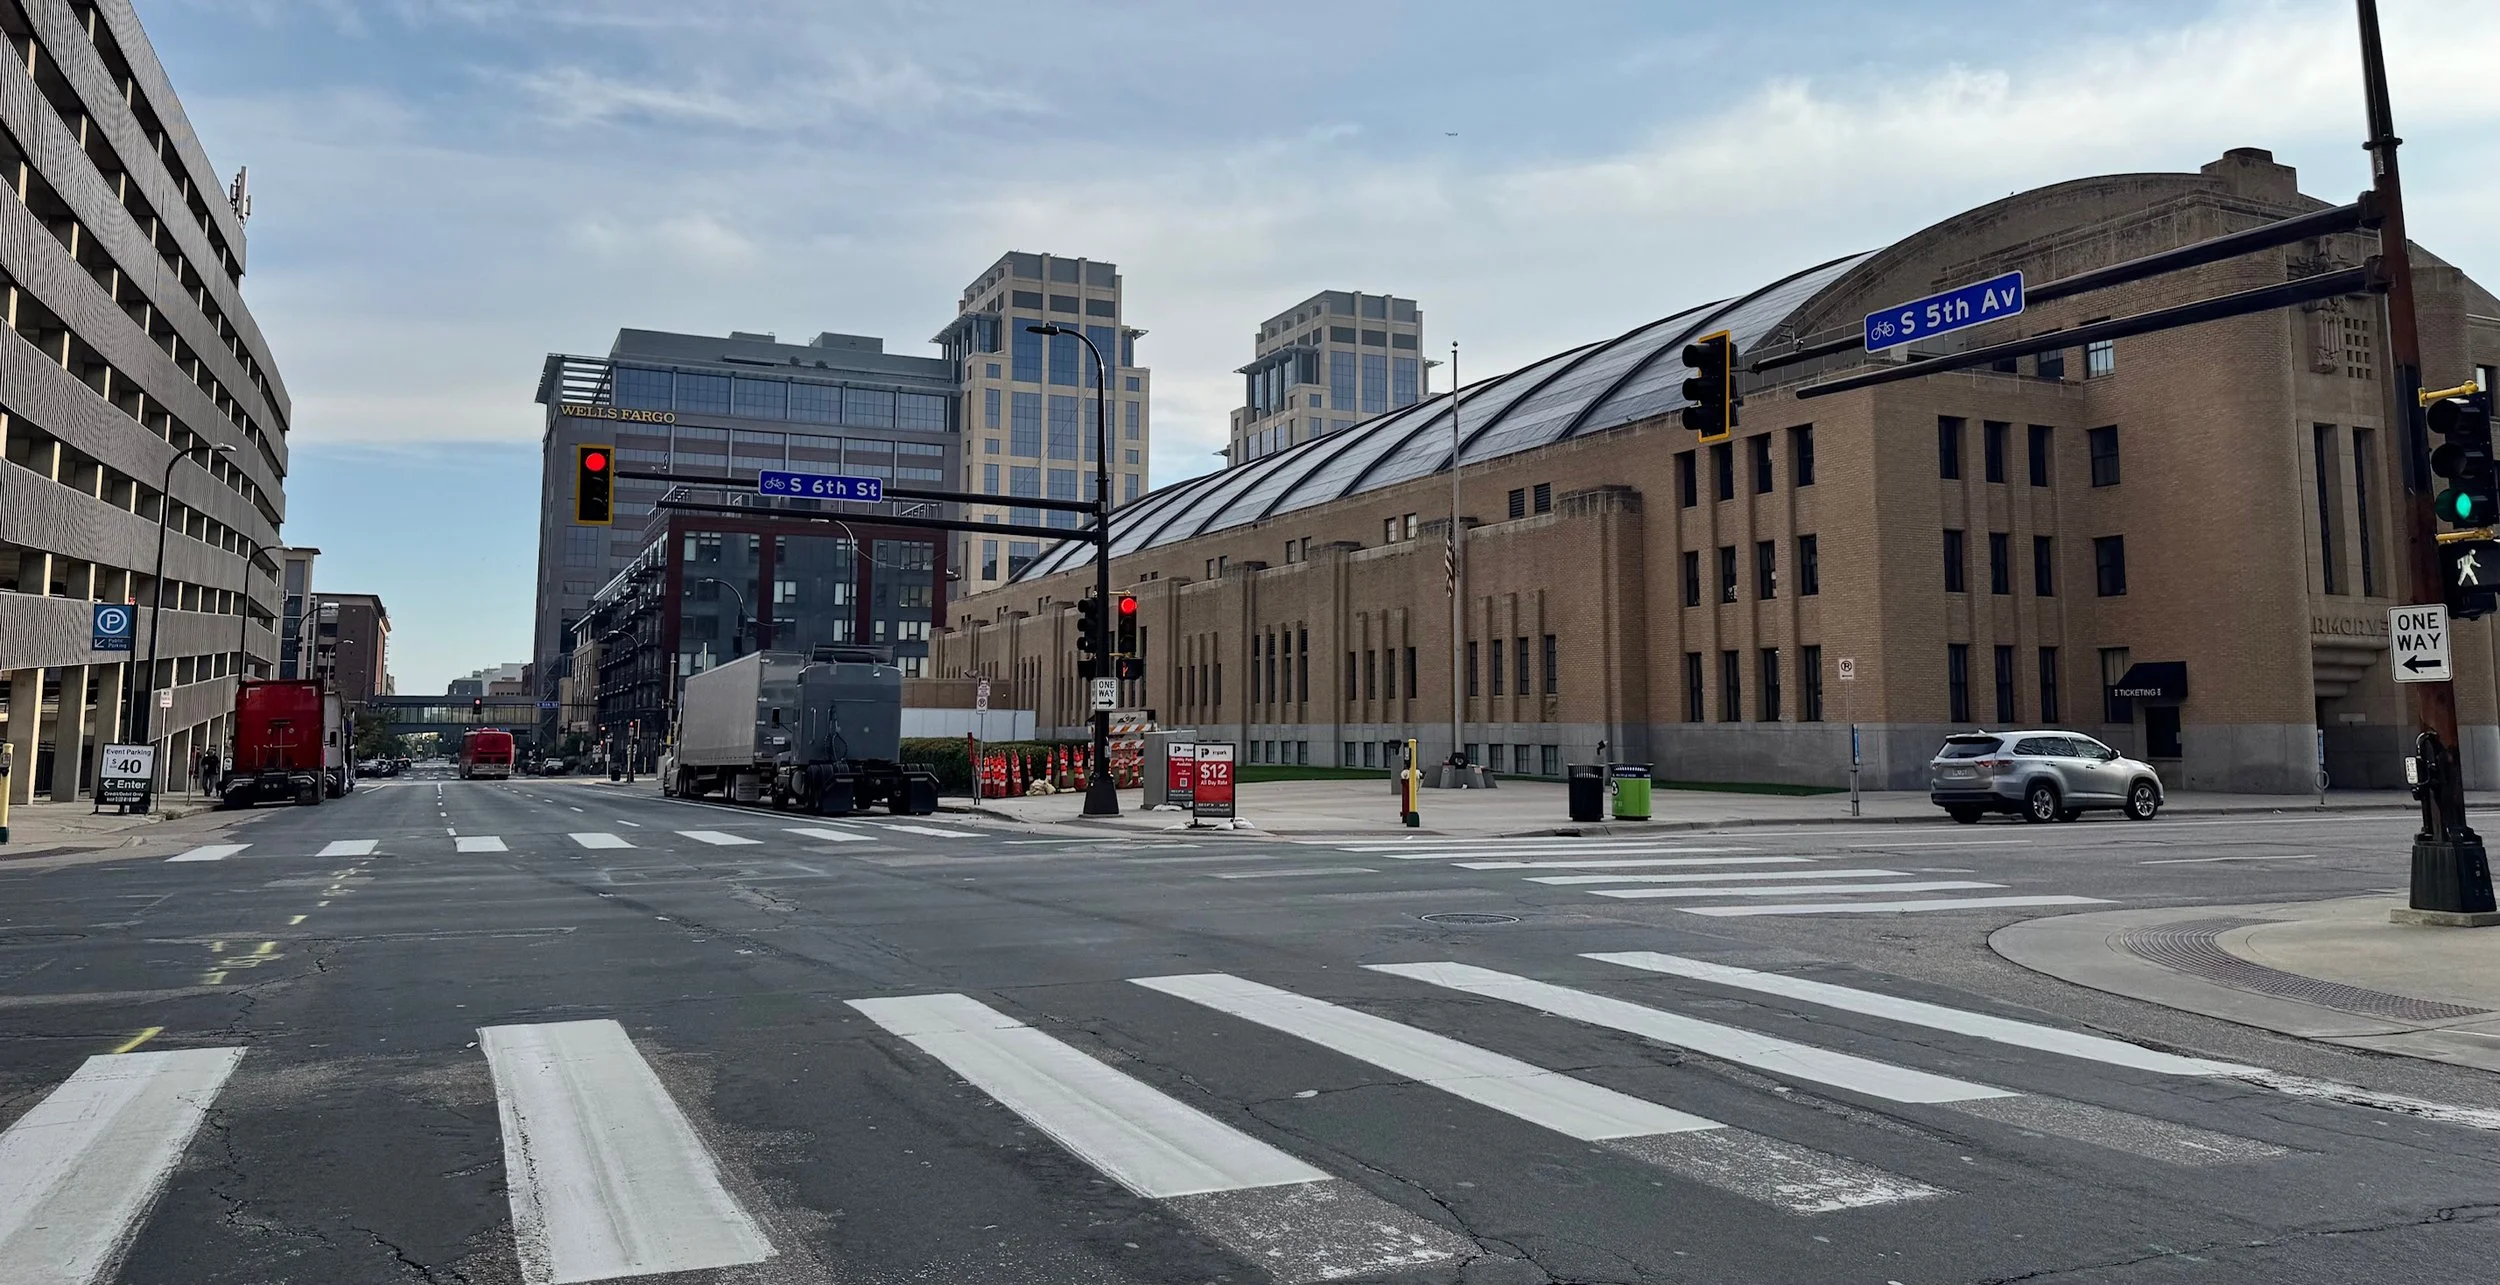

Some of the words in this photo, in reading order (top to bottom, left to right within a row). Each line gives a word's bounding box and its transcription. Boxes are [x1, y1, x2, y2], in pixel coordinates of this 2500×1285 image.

[1901, 311, 1916, 335] S
[1926, 297, 1969, 328] 5th
[1981, 287, 2016, 314] Av
[560, 404, 618, 420] WELLS
[621, 408, 676, 424] FARGO
[790, 478, 802, 492] S
[812, 479, 847, 495] 6th
[856, 482, 877, 497] St
[2398, 612, 2439, 631] ONE
[2397, 632, 2441, 651] WAY
[1098, 680, 1115, 689] ONE
[1098, 689, 1115, 697] WAY
[2119, 688, 2156, 697] TICKETING
[126, 749, 152, 757] Parking
[1200, 762, 1228, 780] $12
[116, 780, 146, 789] Enter
